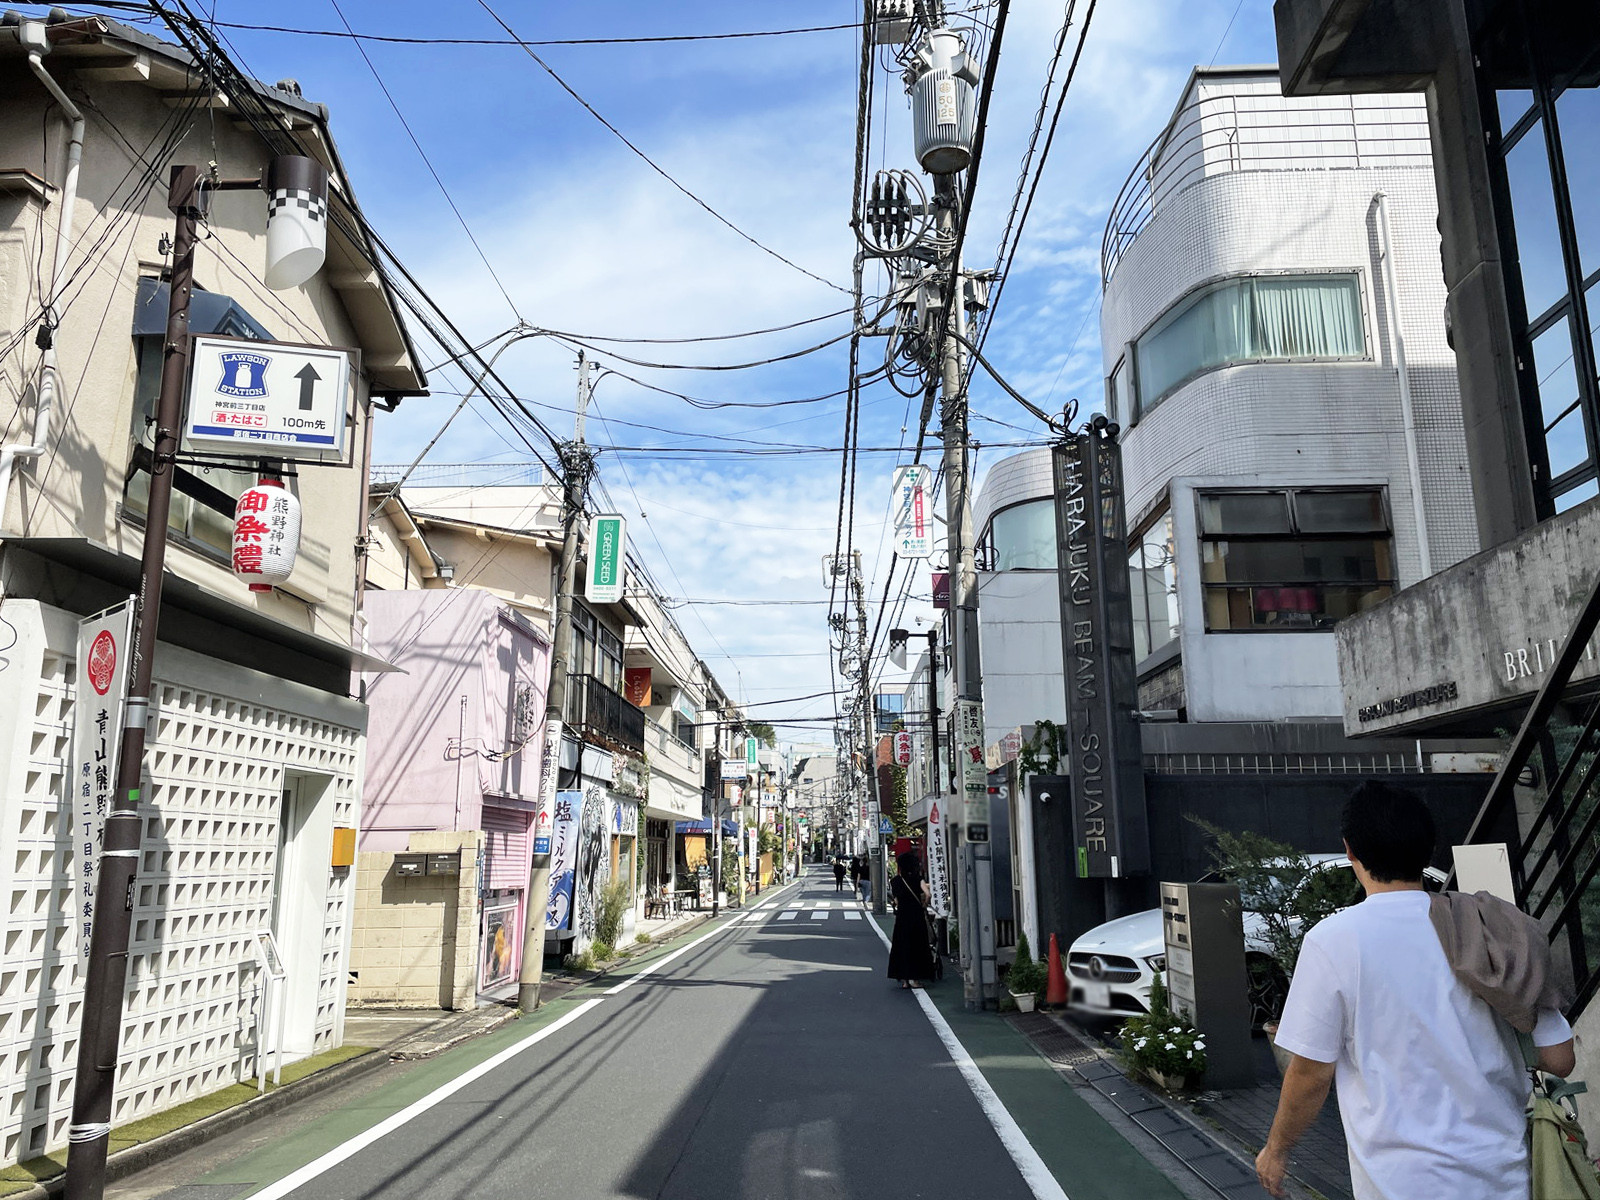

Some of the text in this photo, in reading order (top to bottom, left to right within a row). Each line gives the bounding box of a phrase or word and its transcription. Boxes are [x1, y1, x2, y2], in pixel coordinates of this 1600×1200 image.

[223, 353, 268, 366] LAWSON
[215, 401, 266, 411] 神宮前三丁目店
[219, 384, 264, 396] STATION
[282, 417, 326, 430] 100m先
[232, 490, 271, 574] 御祭禮
[268, 497, 289, 557] 熊野神社
[602, 531, 613, 561] GREEN
[1064, 461, 1092, 607] HARAJUKU
[600, 561, 611, 584] SEED
[1073, 619, 1097, 700] BEAM
[1080, 733, 1107, 853] SQUARE
[82, 762, 94, 957] 原宿二丁目祭礼委員会
[548, 800, 573, 924] 塩ミルクアイス
